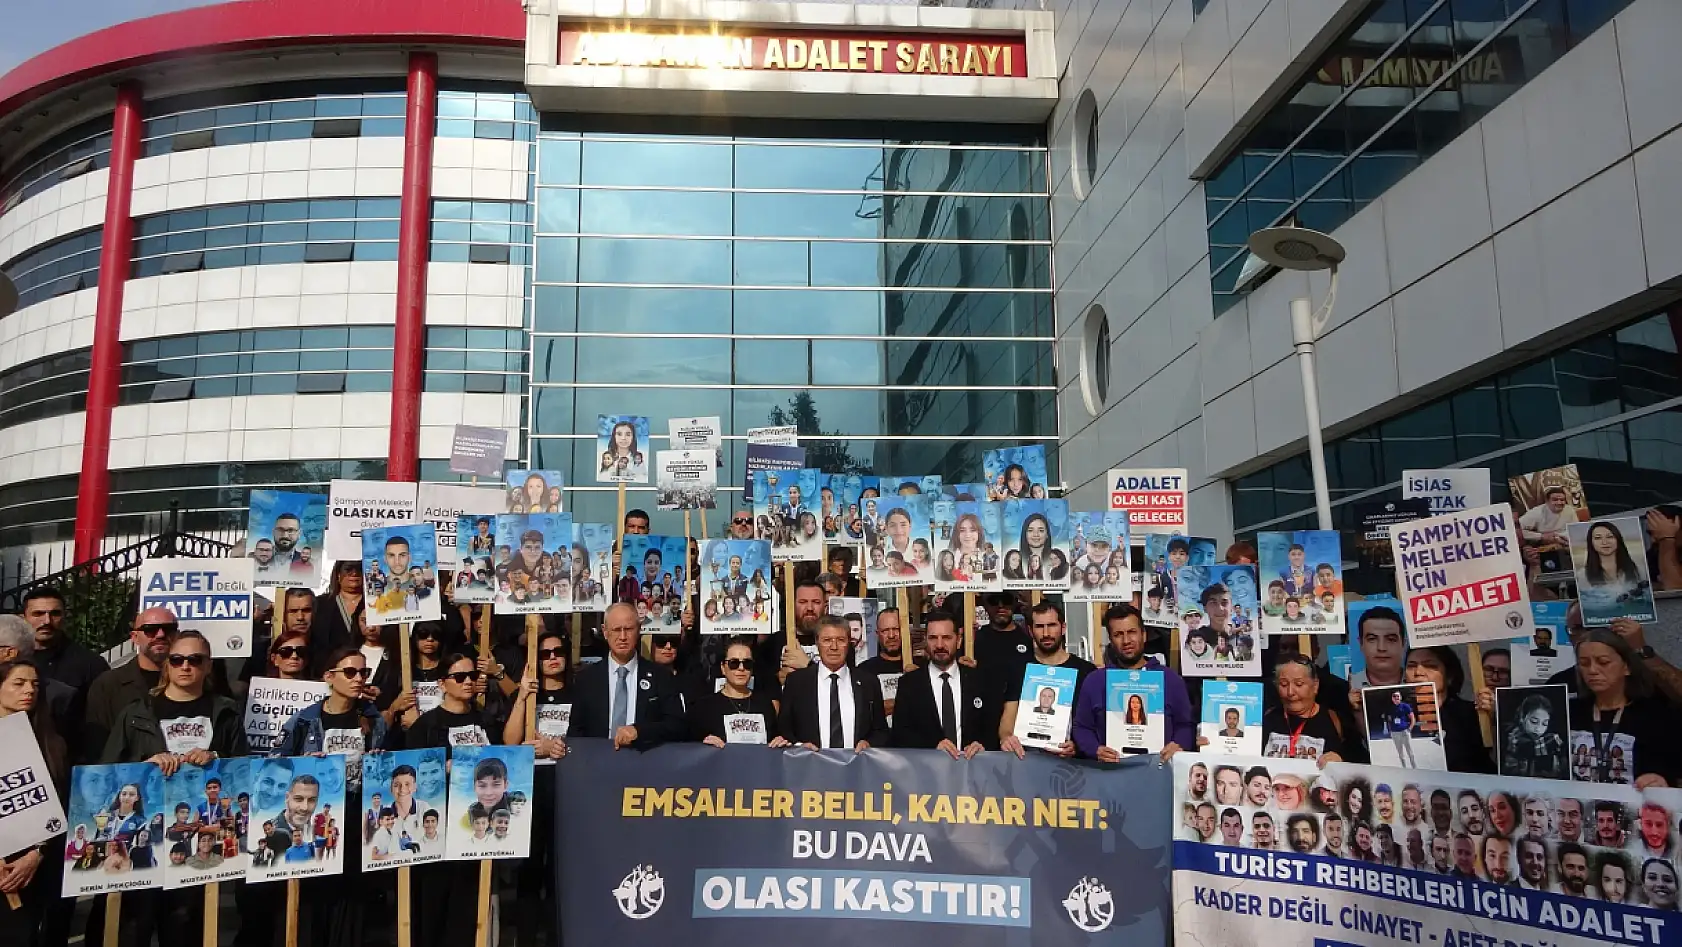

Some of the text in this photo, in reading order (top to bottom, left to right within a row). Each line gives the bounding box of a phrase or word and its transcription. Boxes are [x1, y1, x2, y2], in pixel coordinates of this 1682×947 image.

[763, 38, 889, 72] ADALET
[896, 42, 1013, 75] SARAYI
[1115, 476, 1182, 490] ADALET
[1409, 476, 1452, 492] İSİAS
[334, 497, 413, 507] Şampiyon Melekler
[1113, 495, 1182, 505] OLASI KAST
[333, 507, 414, 520] OLASI KAST
[1129, 511, 1183, 523] GELECEK
[1397, 512, 1506, 551] ŞAMPİYON
[1401, 536, 1510, 570] MELEKLER
[147, 571, 248, 592] AFET DEĞİL
[1404, 568, 1448, 593] İÇİN
[1416, 577, 1513, 622] ADALET
[253, 688, 300, 702] Birlikte
[248, 719, 282, 731] Adal
[622, 782, 1108, 829] EMSALLER BELLİ, KARAR NET:
[793, 830, 933, 864] BU DAVA
[702, 876, 1021, 919] OLASI KASTTIR!
[1215, 852, 1665, 944] TURİST REHBERLERİ İÇİN ADALET
[1194, 886, 1263, 917] KADER
[1269, 893, 1334, 926] DEĞİL
[1340, 904, 1424, 944] CİNAYET
